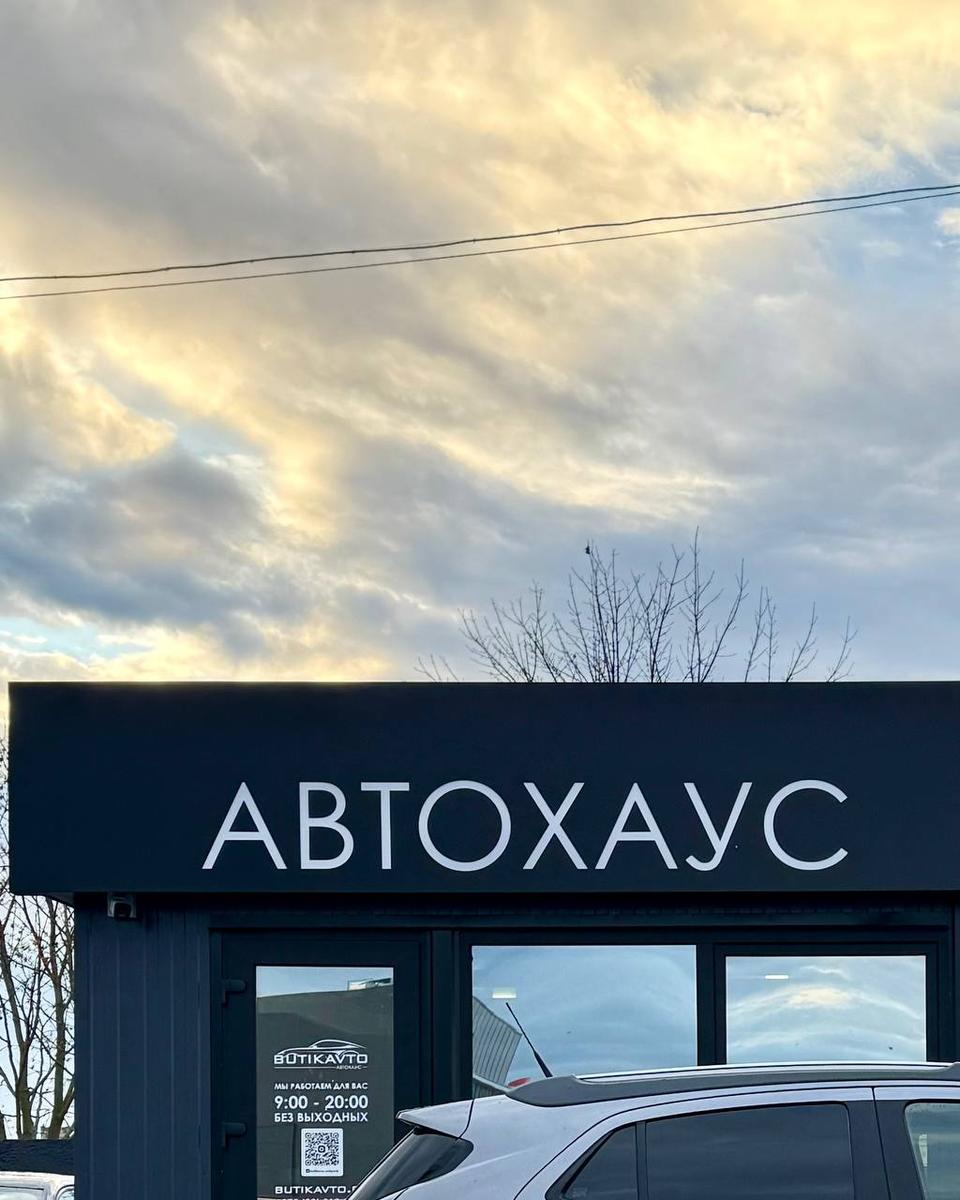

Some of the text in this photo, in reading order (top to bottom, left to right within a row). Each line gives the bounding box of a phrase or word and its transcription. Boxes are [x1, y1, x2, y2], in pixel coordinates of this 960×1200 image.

[202, 780, 849, 873] АВТОХАУС
[274, 1054, 368, 1065] BUTIKAVTO
[333, 1083, 350, 1091] ДЛЯ
[274, 1096, 308, 1109] 9:00
[325, 1095, 368, 1109] 20:00
[274, 1112, 368, 1123] БЕЗ ВЫХОДНЫХ
